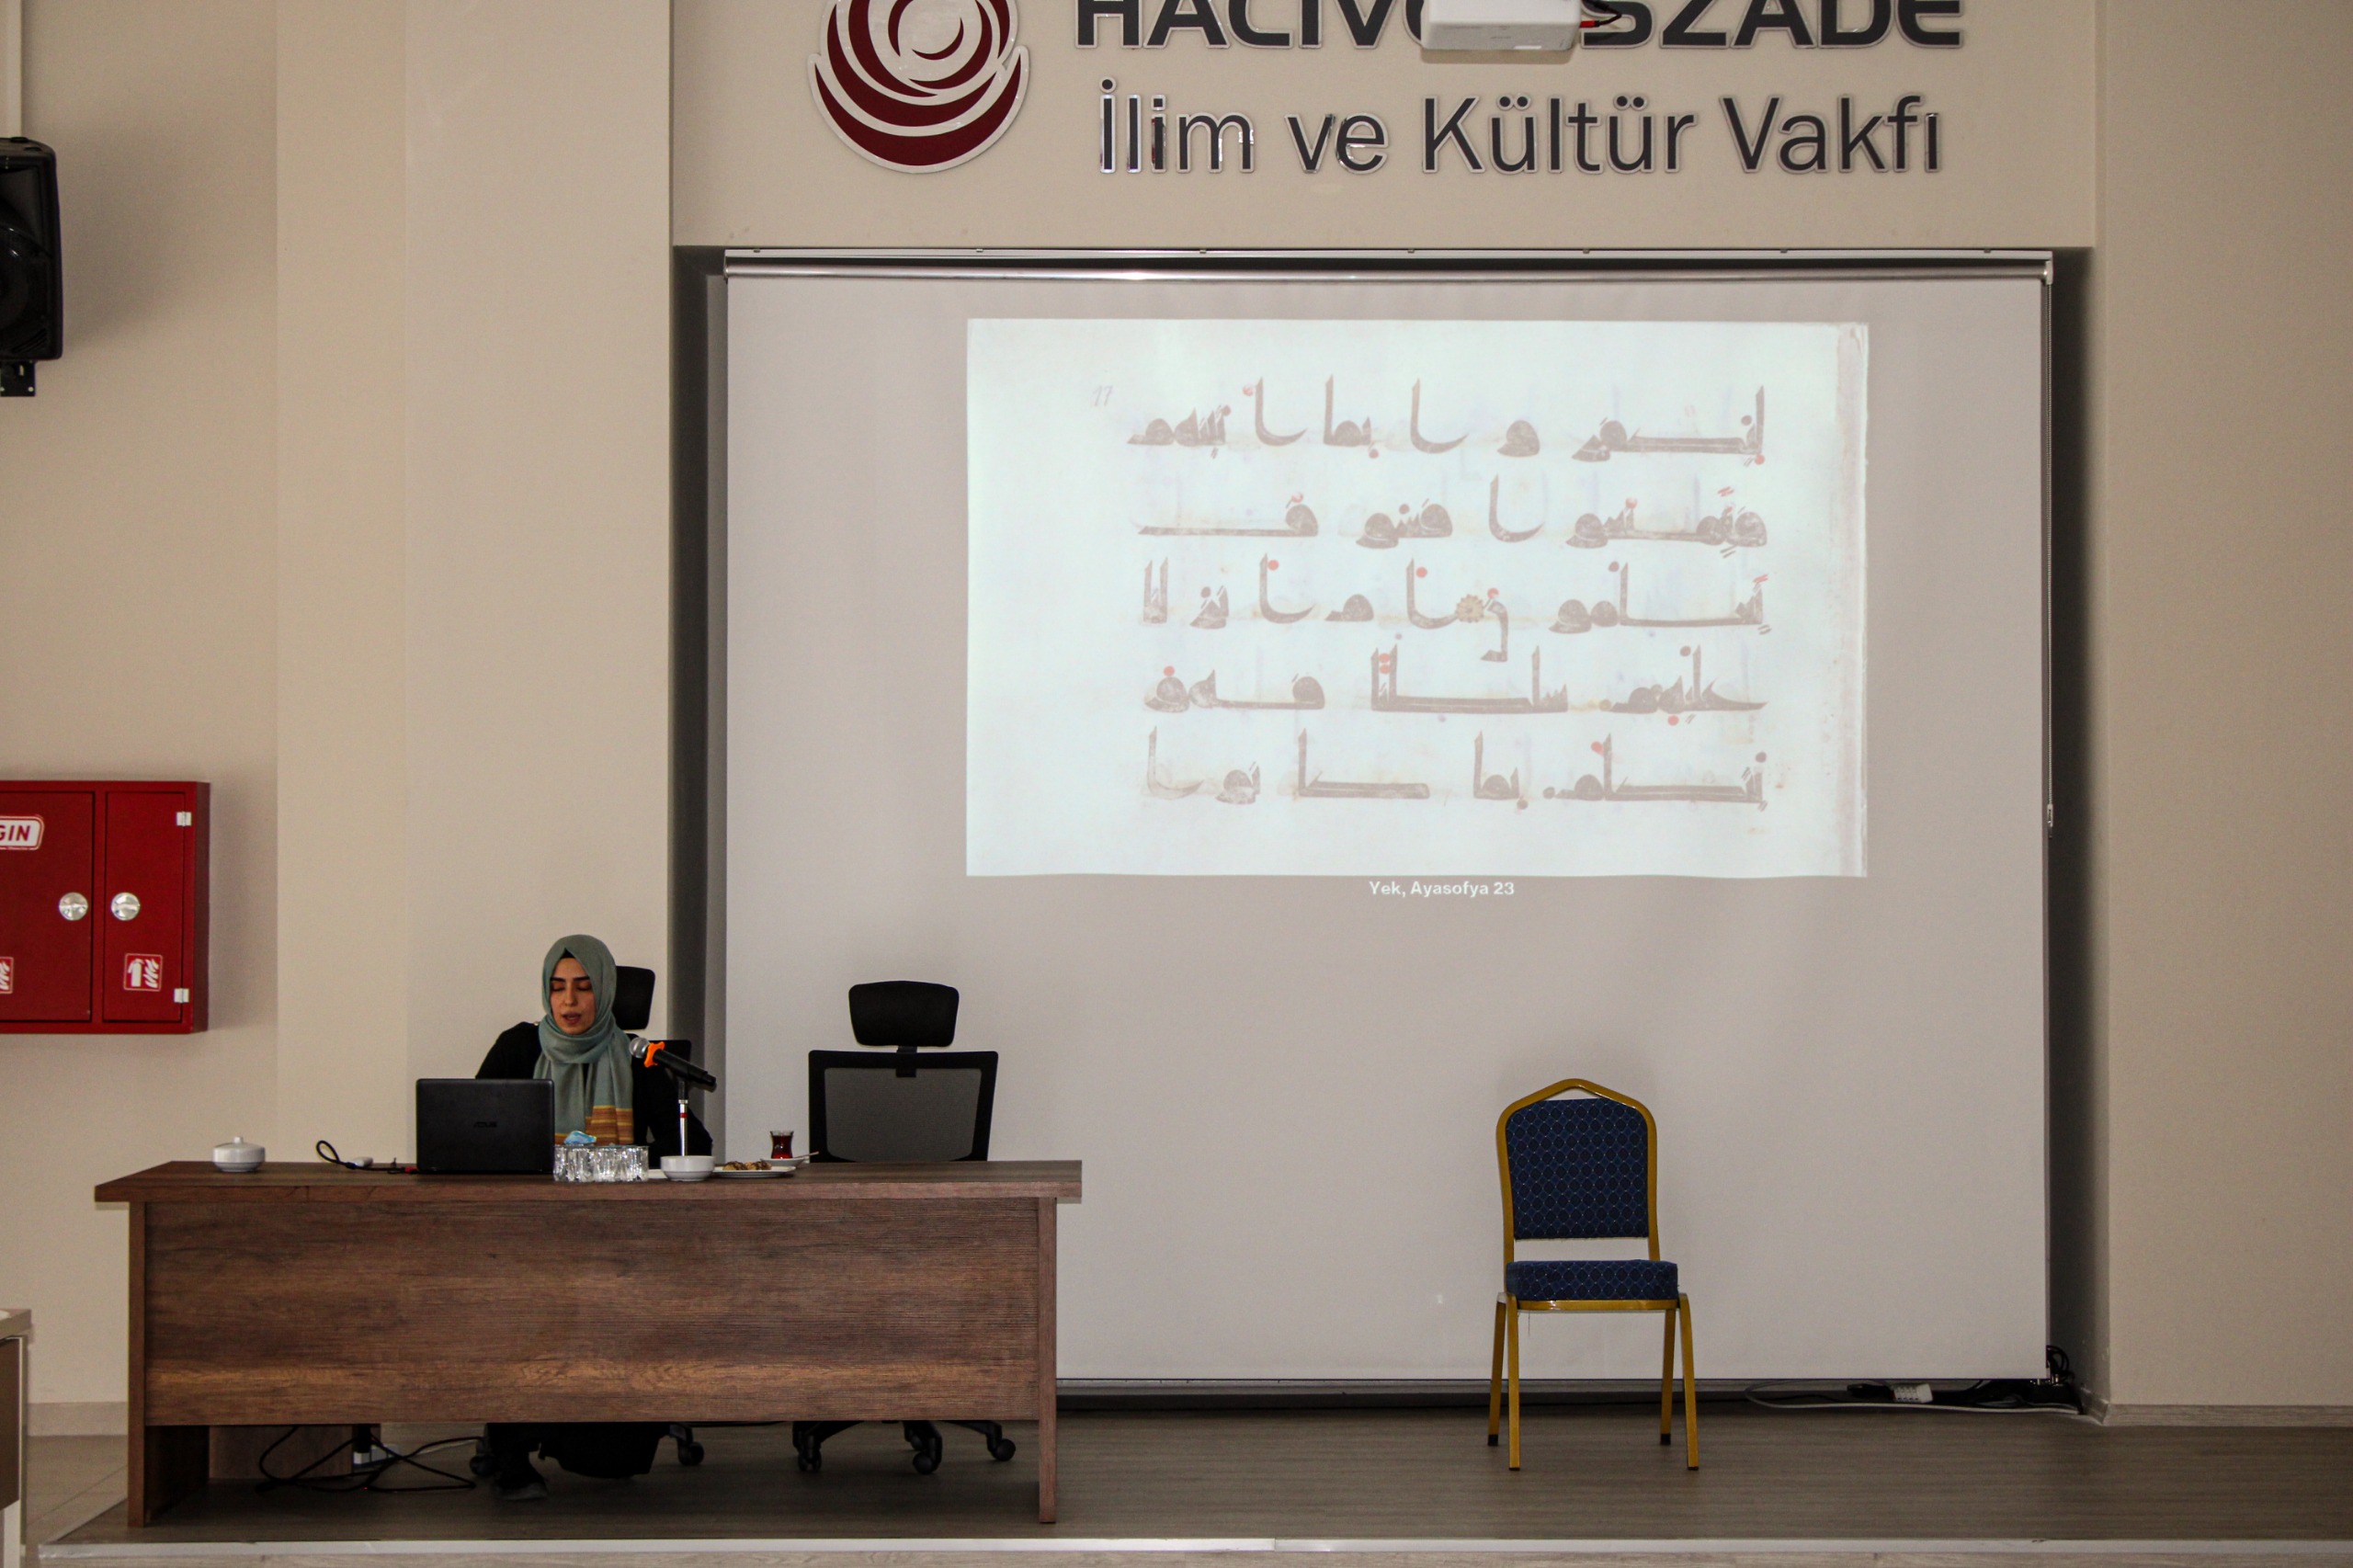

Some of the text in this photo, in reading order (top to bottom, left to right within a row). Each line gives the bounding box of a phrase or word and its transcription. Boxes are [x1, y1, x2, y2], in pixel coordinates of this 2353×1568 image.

[1100, 78, 1939, 173] İlim ve Kültür Vakfı
[1369, 881, 1515, 898] Yek, Ayasofya 23
